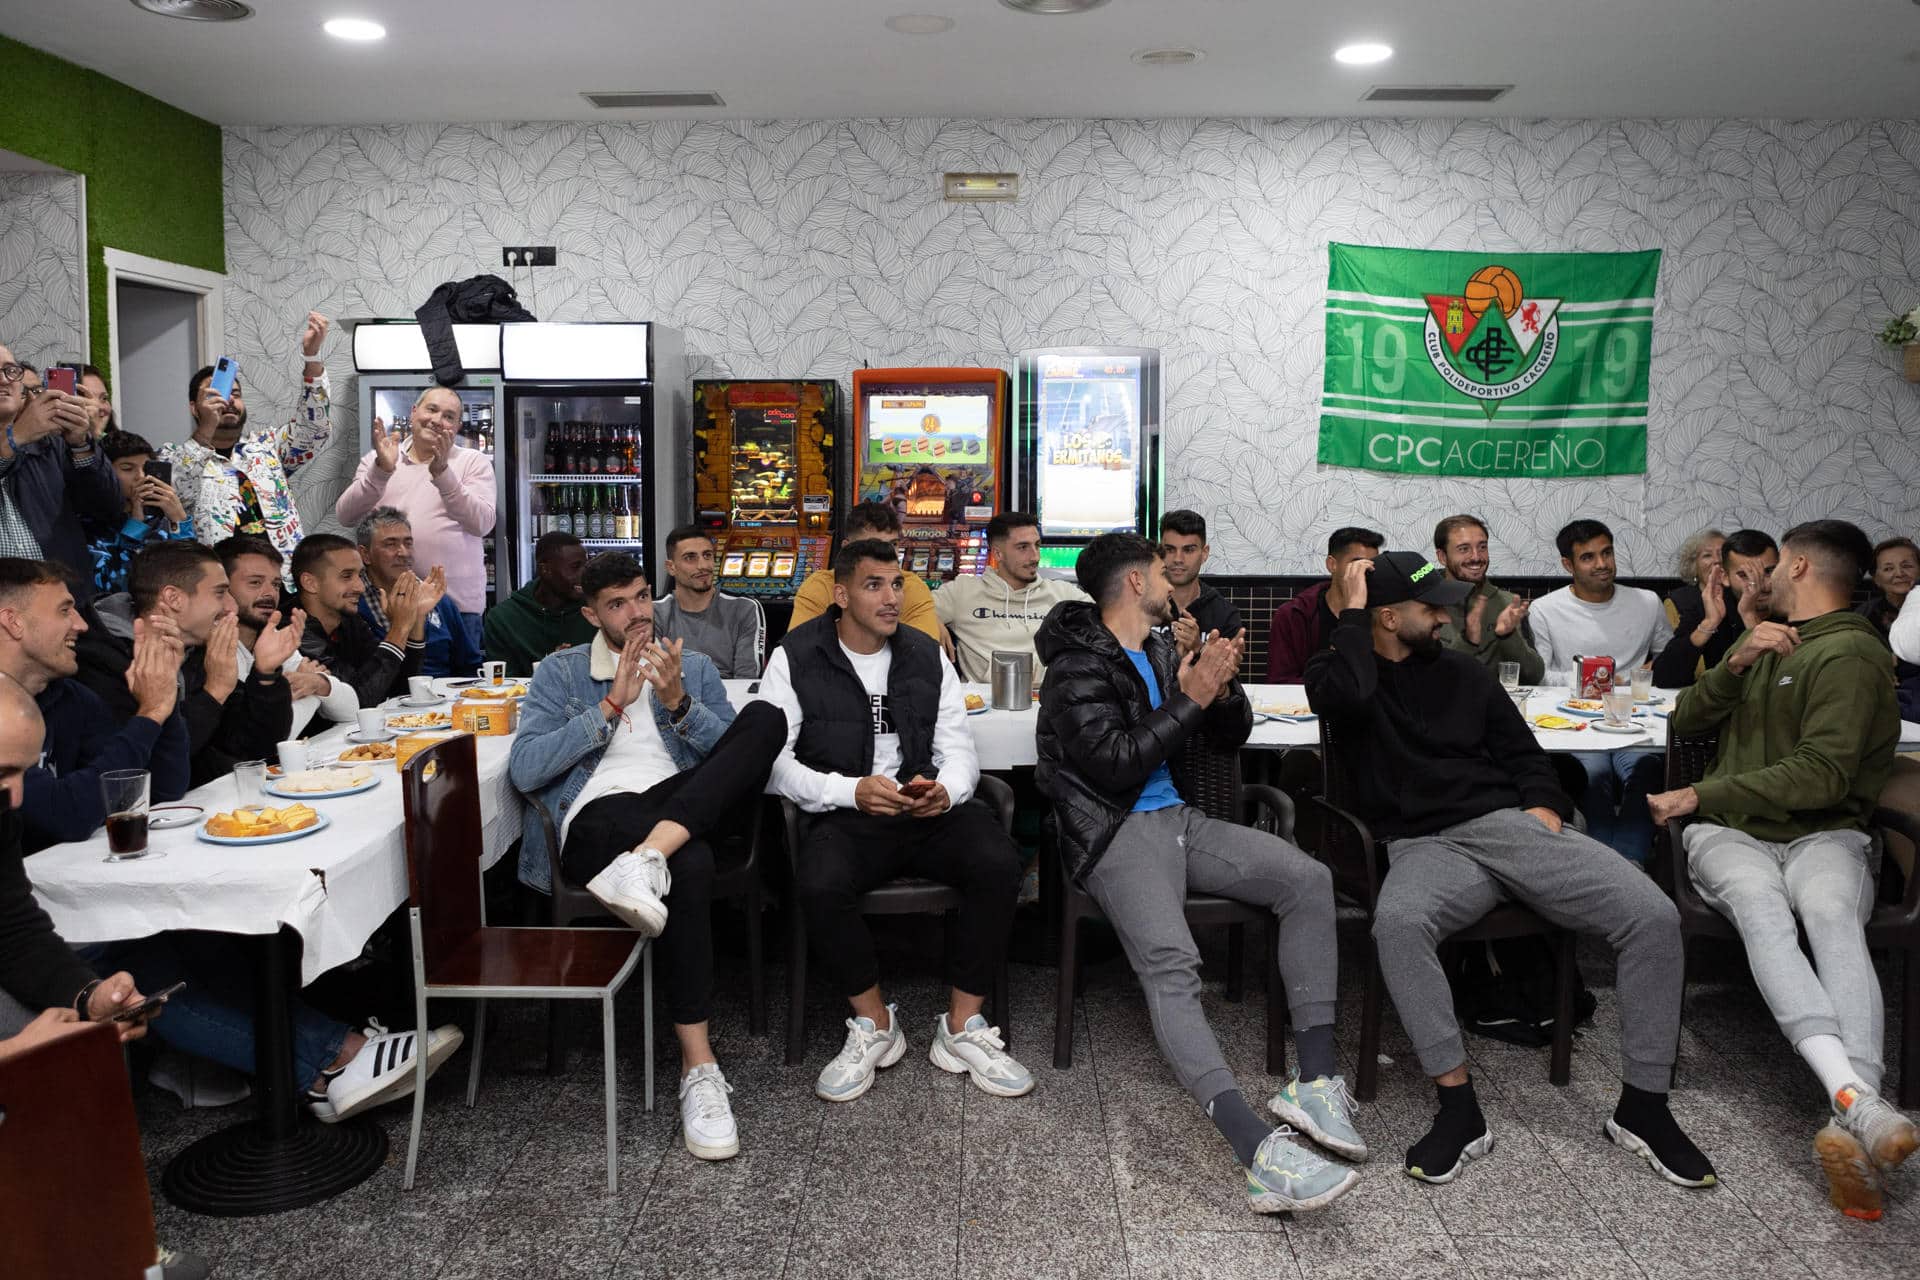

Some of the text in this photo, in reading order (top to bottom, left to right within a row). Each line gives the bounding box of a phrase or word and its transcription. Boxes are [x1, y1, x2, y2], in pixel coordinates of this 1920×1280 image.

[1342, 322, 1407, 393] 19
[1428, 331, 1555, 396] CLUB POLIDEPORTIVO CACEREÑO
[1574, 327, 1638, 398] 19
